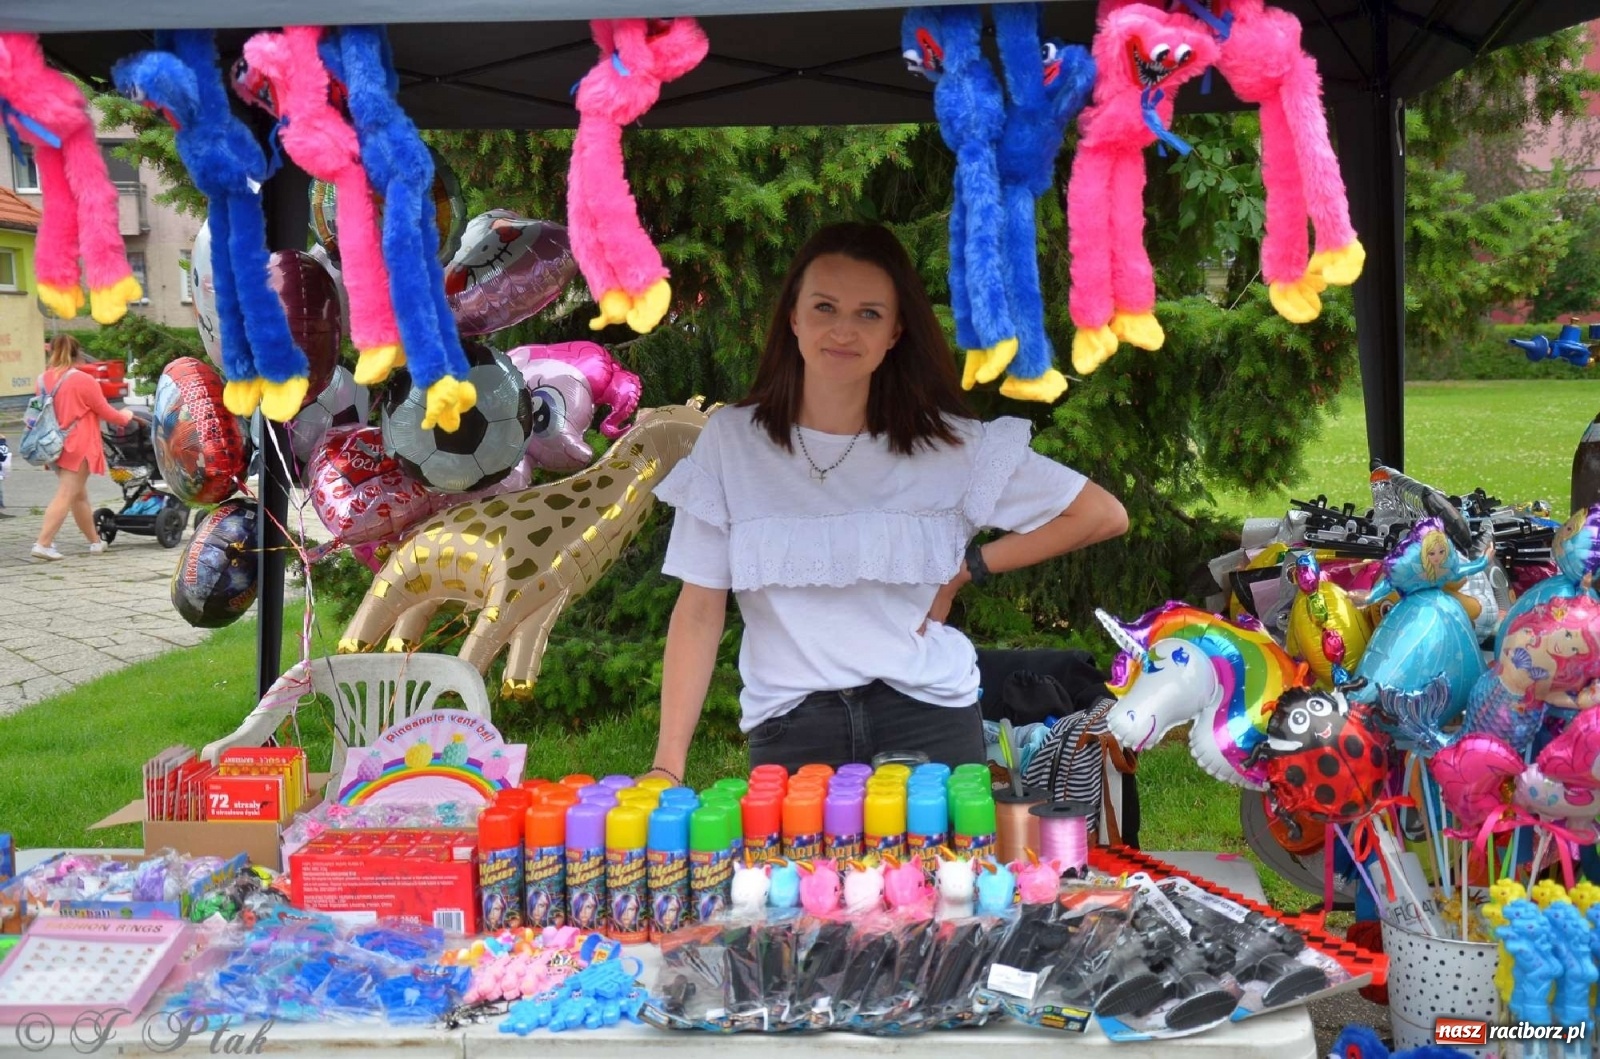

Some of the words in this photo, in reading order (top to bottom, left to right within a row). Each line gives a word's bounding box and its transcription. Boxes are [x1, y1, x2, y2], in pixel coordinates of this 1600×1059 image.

[385, 713, 445, 743] Pineapple
[449, 714, 477, 728] vent
[476, 723, 496, 743] ball
[209, 793, 230, 809] 72
[608, 857, 645, 877] Hair
[650, 858, 687, 878] Hair
[45, 922, 111, 931] FASHION
[115, 923, 164, 933] RINGS
